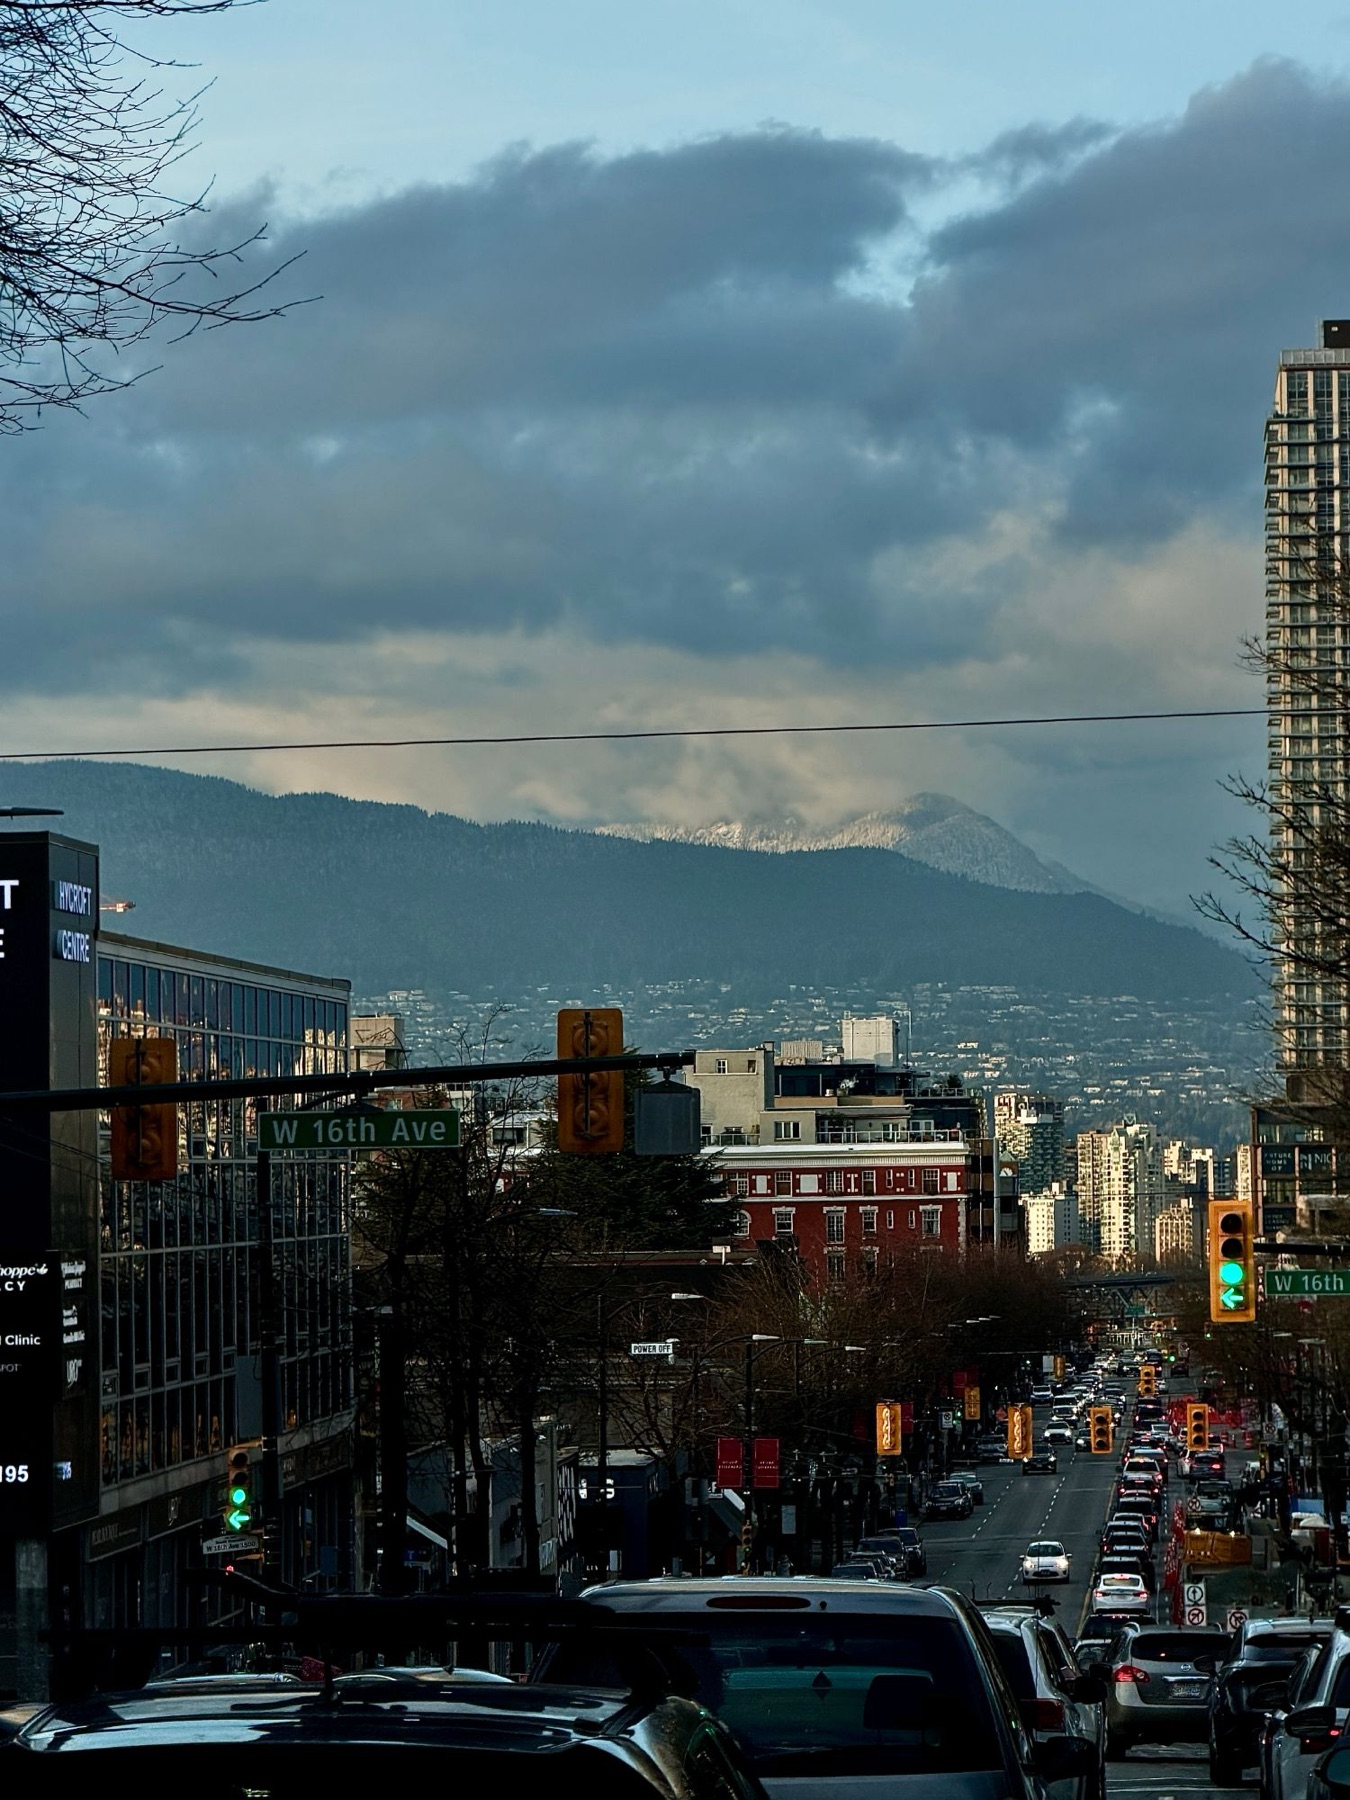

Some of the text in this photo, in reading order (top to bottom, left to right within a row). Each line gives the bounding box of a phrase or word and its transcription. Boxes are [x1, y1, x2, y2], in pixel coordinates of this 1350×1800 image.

[59, 880, 92, 916] HYCROFT
[61, 929, 90, 963] CENTRE
[273, 1116, 446, 1144] W 16th Ave
[0, 1280, 26, 1292] CY
[1274, 1273, 1344, 1292] W 16th
[5, 1333, 41, 1346] Clinic
[633, 1344, 671, 1353] POWER OFF
